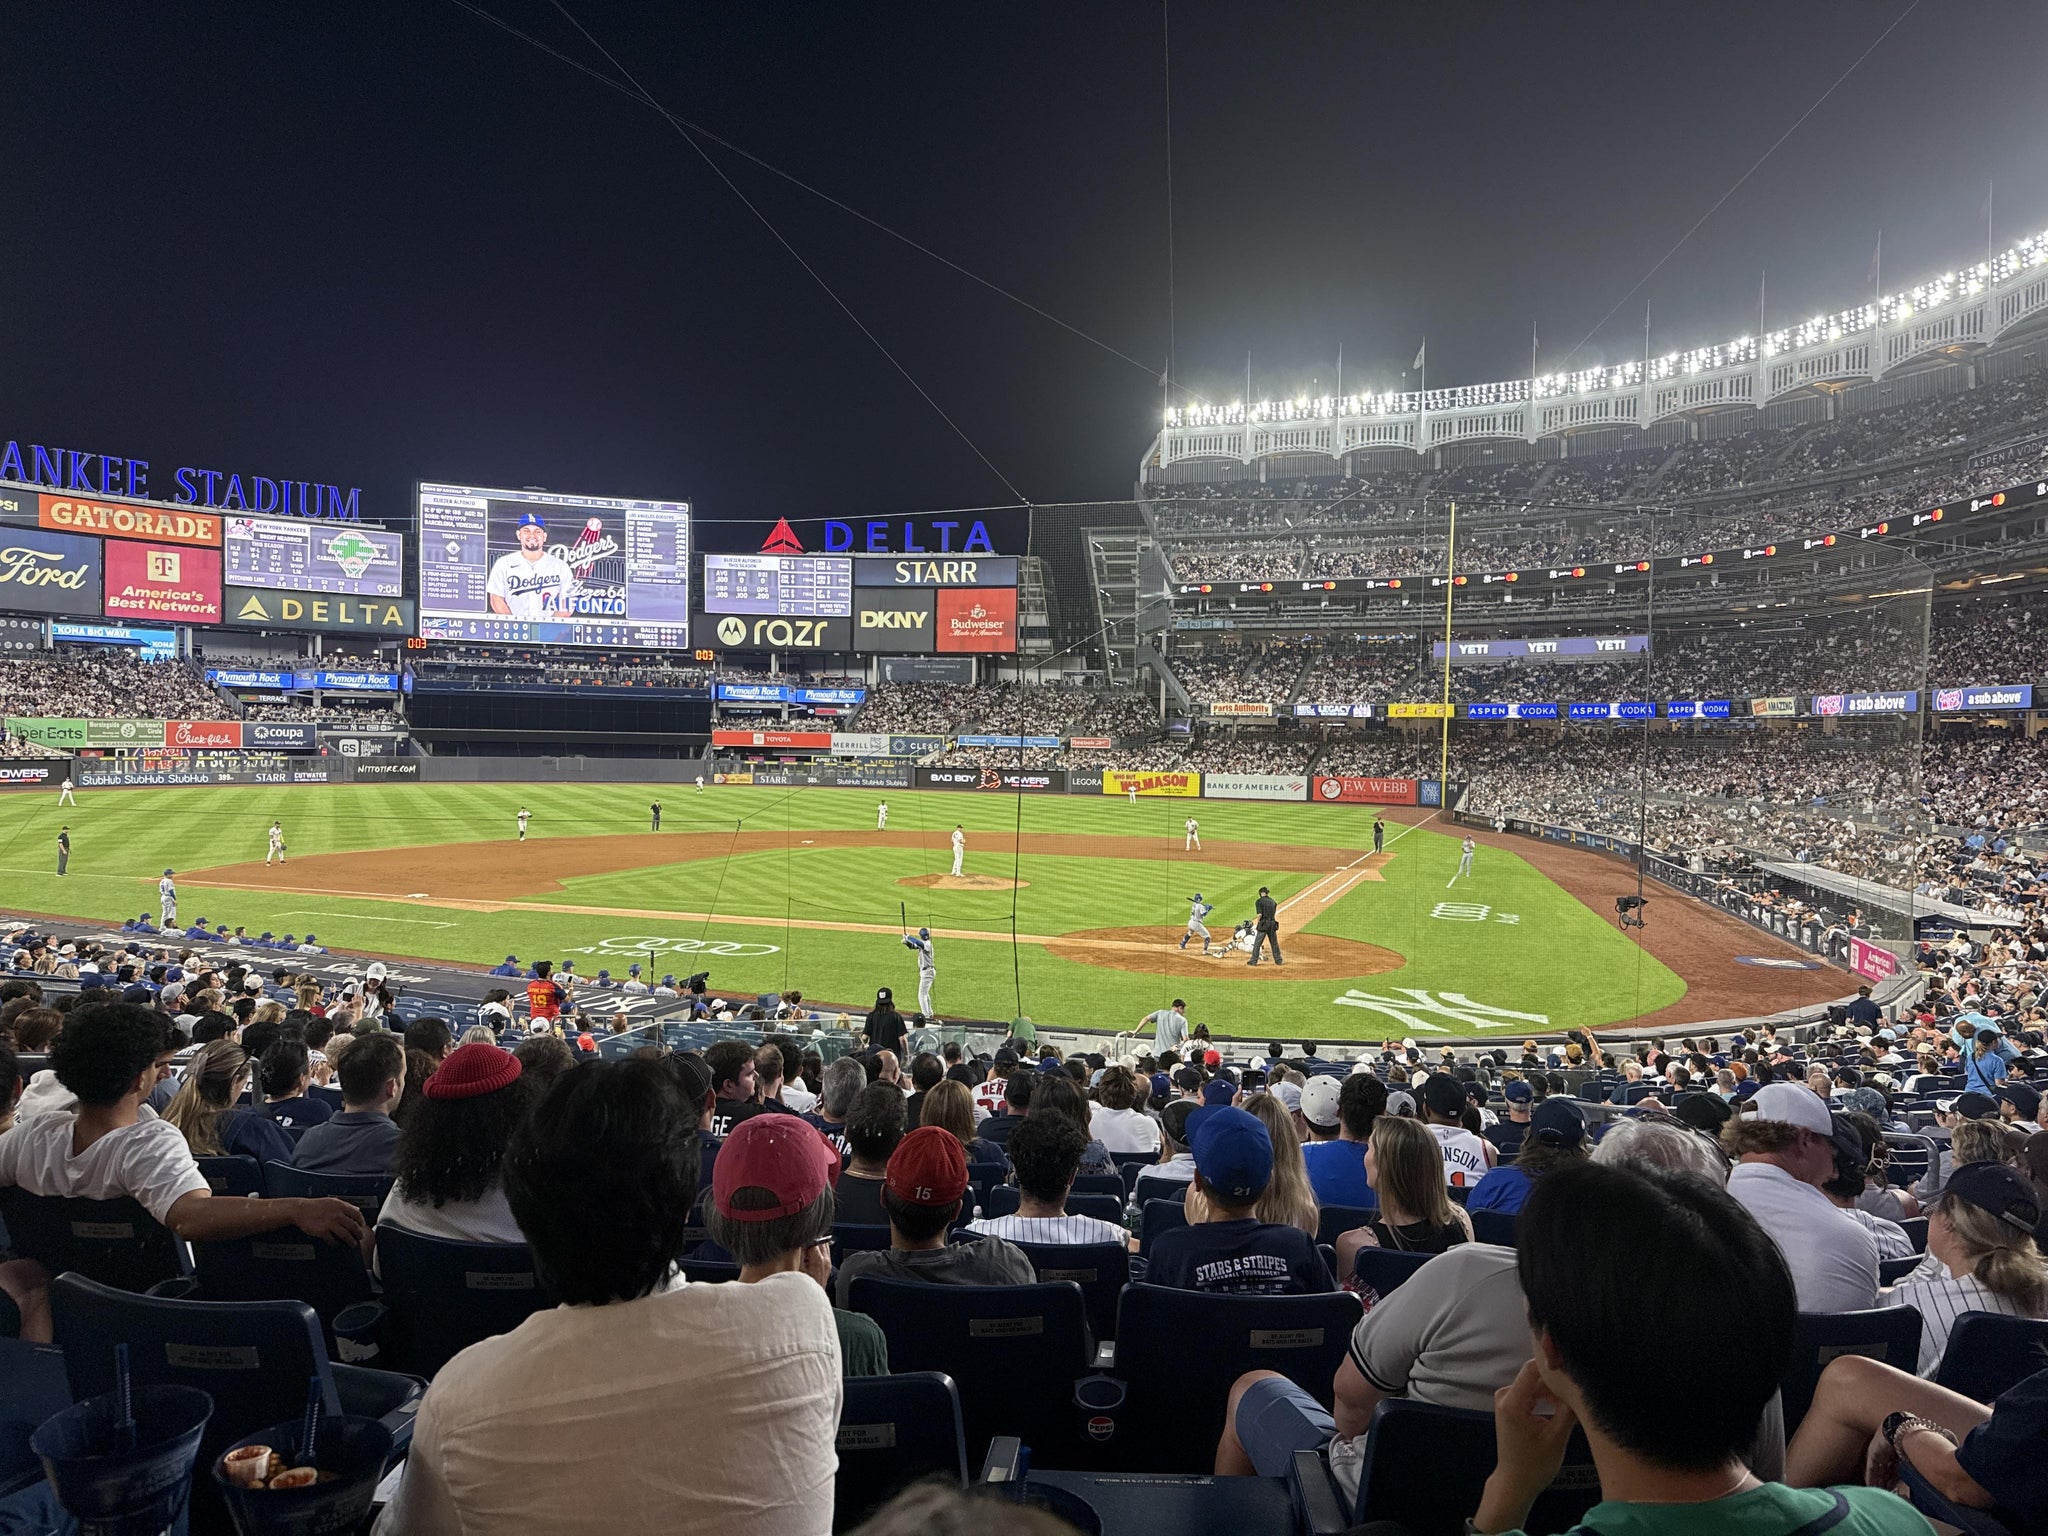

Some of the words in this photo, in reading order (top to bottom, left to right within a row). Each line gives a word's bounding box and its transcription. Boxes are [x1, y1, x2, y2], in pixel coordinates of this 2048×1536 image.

[1974, 452, 2004, 467] ASPEN
[175, 467, 362, 521] STADIUM
[51, 502, 213, 540] GATORADE
[824, 521, 993, 553] DELTA
[548, 535, 618, 569] Dodgers
[0, 547, 89, 590] Ford
[895, 561, 977, 583] STARR
[377, 585, 398, 593] 9:04
[507, 573, 560, 595] Dodgers
[122, 586, 204, 602] America's
[607, 586, 626, 599] 64
[108, 596, 145, 610] Best
[148, 599, 217, 614] Network
[544, 597, 626, 615] ALFONZO
[282, 599, 403, 626] DELTA
[860, 611, 928, 628] DKNY
[951, 618, 1004, 629] Budweiser
[58, 626, 85, 634] KONA
[88, 627, 103, 636] BIG
[106, 629, 131, 638] WAVE
[753, 619, 828, 647] razr
[976, 629, 1003, 637] America
[407, 638, 426, 649] 0:03
[1459, 644, 1488, 654] YETI
[1528, 642, 1557, 653] YETI
[1596, 640, 1625, 651] YETI
[695, 650, 714, 661] 0:03
[217, 672, 258, 684] Plymouth
[259, 674, 280, 683] Rock
[325, 673, 366, 685] Plymouth
[368, 674, 390, 684] Rock
[725, 685, 760, 696] Plymouth
[761, 687, 780, 695] Rock
[805, 690, 837, 700] Plymouth
[838, 691, 855, 699] Rock
[1856, 698, 1873, 710] sub
[1874, 697, 1904, 710] above
[1973, 692, 1990, 704] sub
[1992, 691, 2021, 703] above
[1213, 705, 1233, 713] Parts
[1234, 704, 1269, 713] Authority
[1318, 705, 1351, 713] LEGACY
[1470, 707, 1505, 715] ASPEN
[1521, 707, 1556, 715] VODKA
[1572, 707, 1608, 715] ASPEN
[1621, 706, 1652, 715] VODKA
[1704, 705, 1728, 713] VODKA
[1768, 702, 1793, 711] AMAZING
[47, 727, 83, 739] Eats
[270, 728, 303, 739] coupa
[342, 744, 356, 752] GS
[910, 742, 939, 750] CLEAR
[357, 765, 416, 773] NITTOTIRE.COM
[82, 775, 121, 785] StubHub
[125, 774, 164, 784] StubHub
[168, 773, 209, 784] StubHub
[256, 773, 286, 782] STARR
[760, 775, 787, 783] STARR
[931, 774, 952, 782] BAD
[1072, 777, 1102, 786] LEGORA
[1143, 774, 1188, 790] MASON
[1343, 780, 1366, 792] F.W.
[1370, 781, 1407, 793] WEBB
[561, 946, 669, 957] Audi
[532, 995, 547, 1007] 19
[1440, 1147, 1479, 1171] NSON
[915, 1186, 932, 1200] 15
[1234, 1187, 1250, 1196] 21
[1196, 1260, 1232, 1281] STARS
[1234, 1258, 1242, 1271] &
[1242, 1255, 1287, 1272] STRIPES
[1209, 1272, 1239, 1281] BASEBALL
[1090, 1424, 1113, 1432] PEPSI
